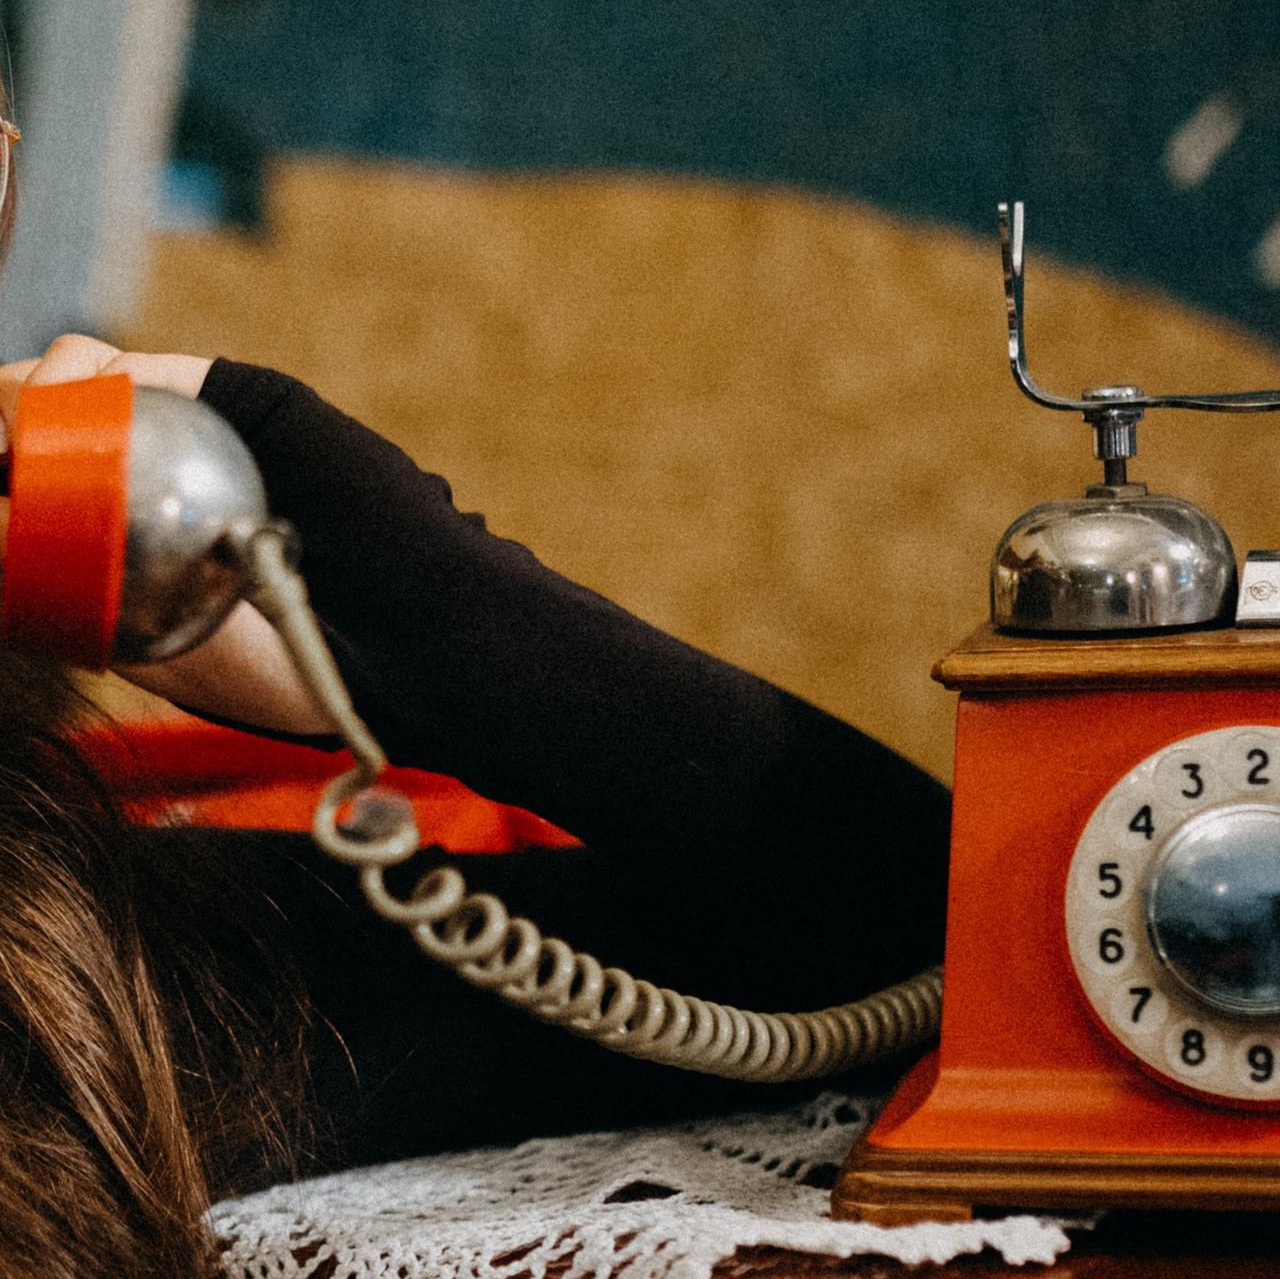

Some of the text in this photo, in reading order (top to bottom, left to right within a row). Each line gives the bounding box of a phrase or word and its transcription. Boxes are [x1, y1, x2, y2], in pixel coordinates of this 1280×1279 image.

[1180, 762, 1205, 800] 3
[1246, 748, 1270, 786] 2
[1127, 804, 1155, 841] 4
[1097, 861, 1123, 899] 5
[1098, 927, 1125, 964] 6
[1128, 986, 1153, 1023] 7
[1180, 1028, 1207, 1067] 8
[1246, 1044, 1275, 1083] 9
